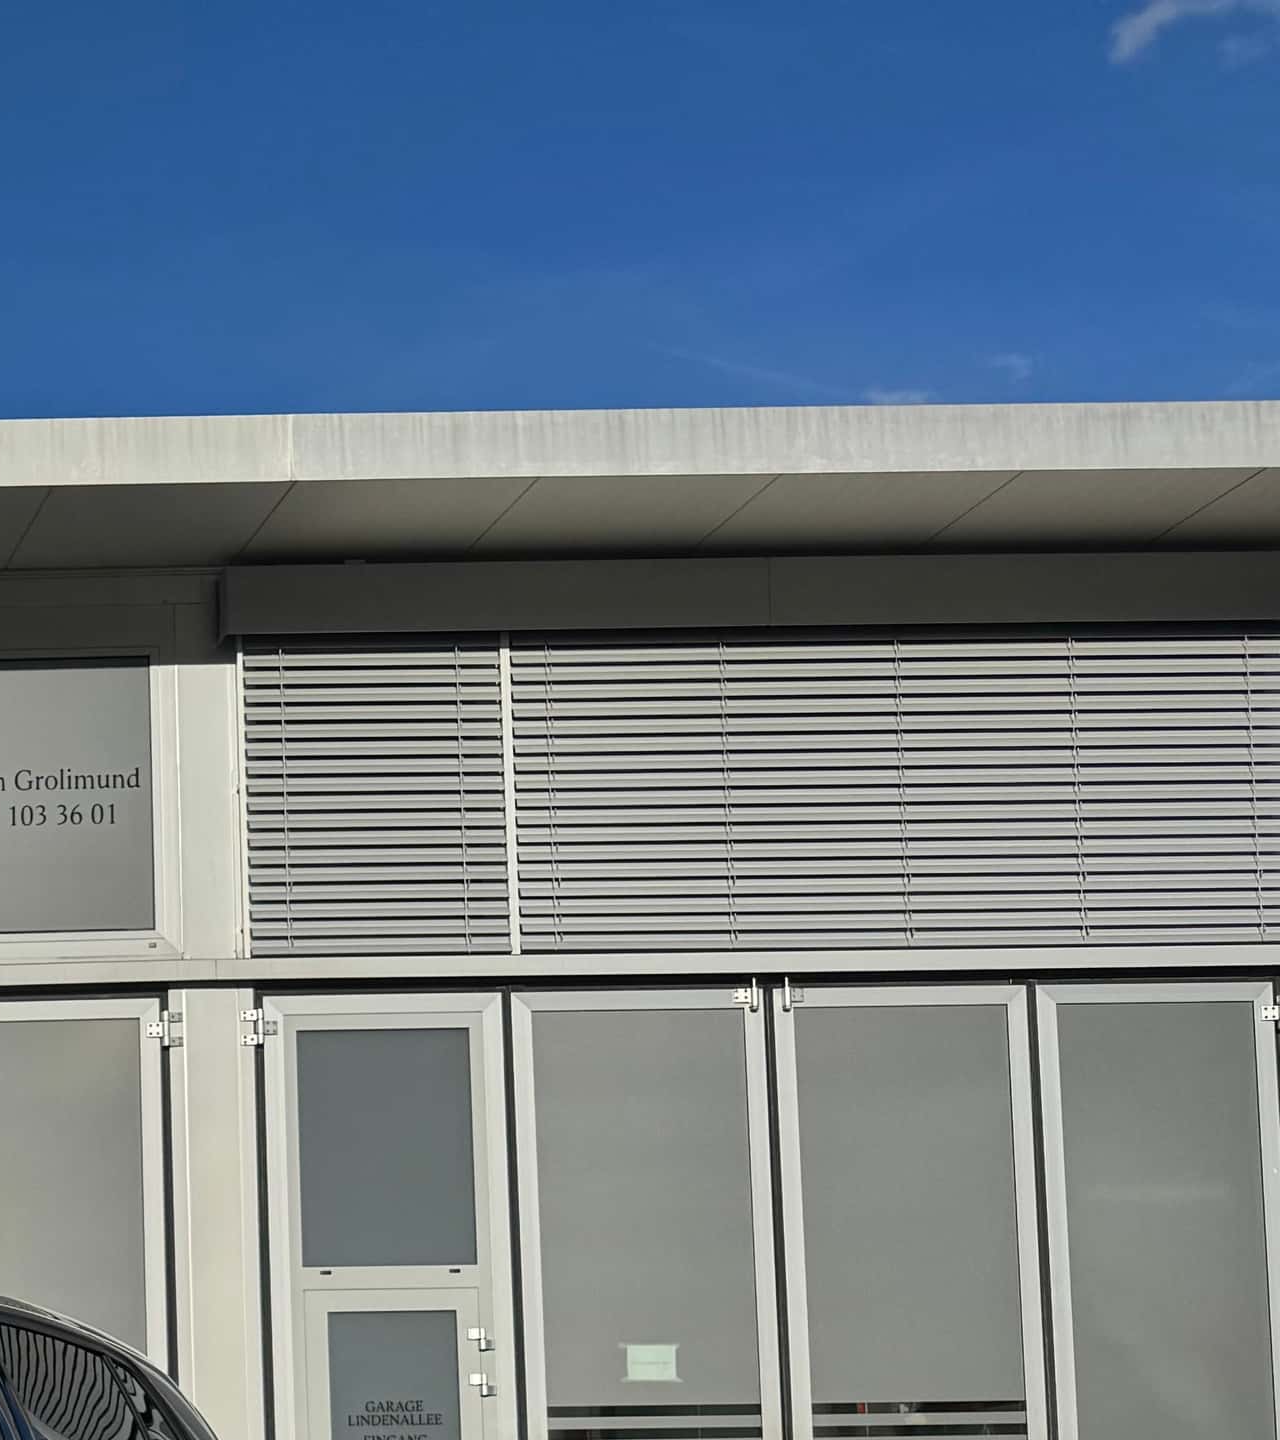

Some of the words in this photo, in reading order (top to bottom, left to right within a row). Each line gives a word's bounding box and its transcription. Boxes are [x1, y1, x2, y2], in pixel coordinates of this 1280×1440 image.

[14, 767, 141, 791] Grolimund
[9, 804, 47, 827] 103
[56, 803, 83, 826] 36
[90, 802, 117, 825] 01
[364, 1399, 424, 1413] GARAGE
[347, 1413, 443, 1427] LINDENALLEE
